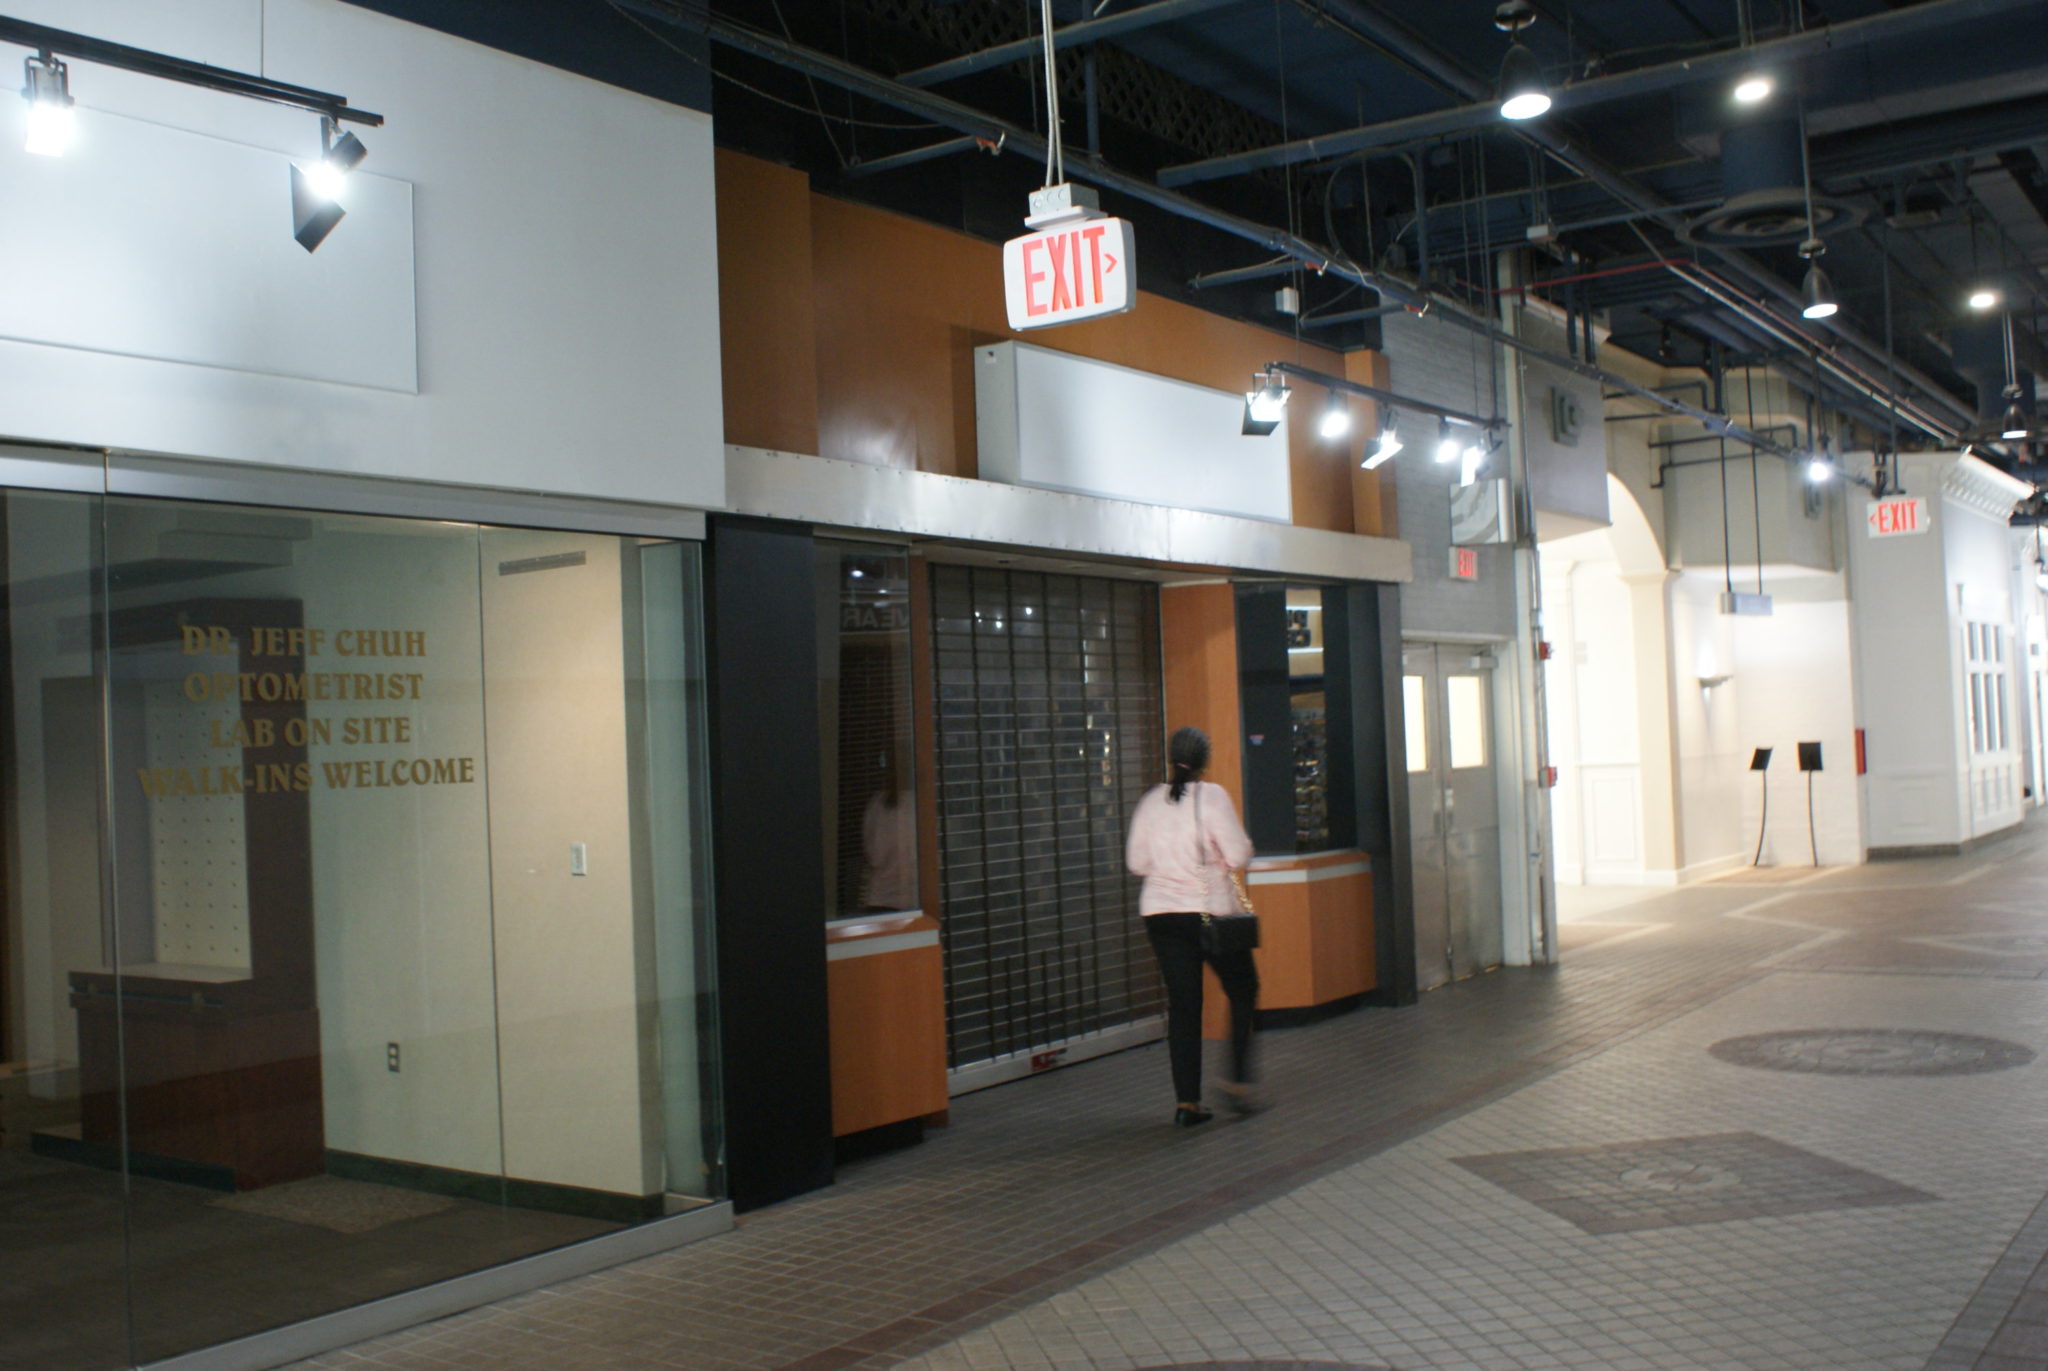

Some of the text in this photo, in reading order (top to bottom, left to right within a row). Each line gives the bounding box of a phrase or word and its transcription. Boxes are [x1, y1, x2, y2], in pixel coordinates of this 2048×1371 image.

[1022, 226, 1105, 317] EXIT
[1878, 500, 1916, 533] EXIT
[251, 627, 325, 656] JEFF
[335, 629, 426, 657] CHUH
[184, 672, 424, 702] OPTOMETRIST
[211, 716, 411, 748] LAB ON SITE
[137, 757, 475, 796] WALK-INS WELCOME
